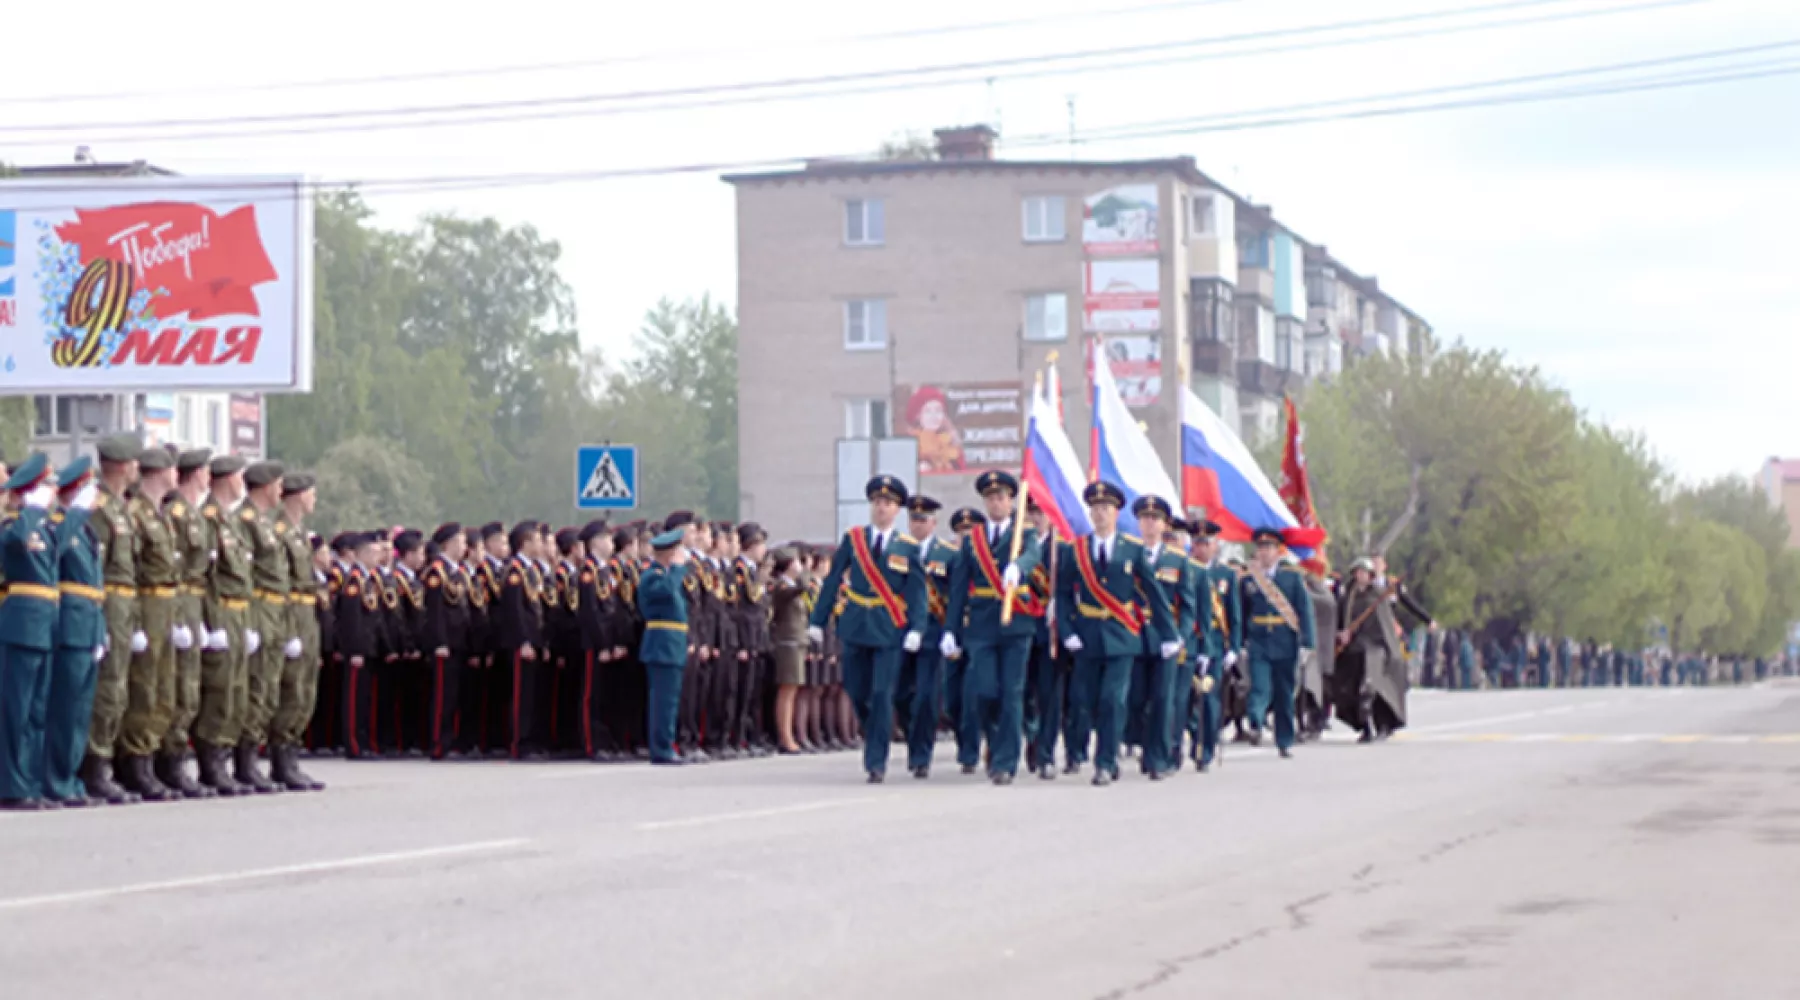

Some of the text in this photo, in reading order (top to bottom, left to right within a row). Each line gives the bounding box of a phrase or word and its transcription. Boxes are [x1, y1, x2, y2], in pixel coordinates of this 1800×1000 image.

[107, 213, 210, 281] Победа!
[52, 258, 262, 368] 9 МАЯ
